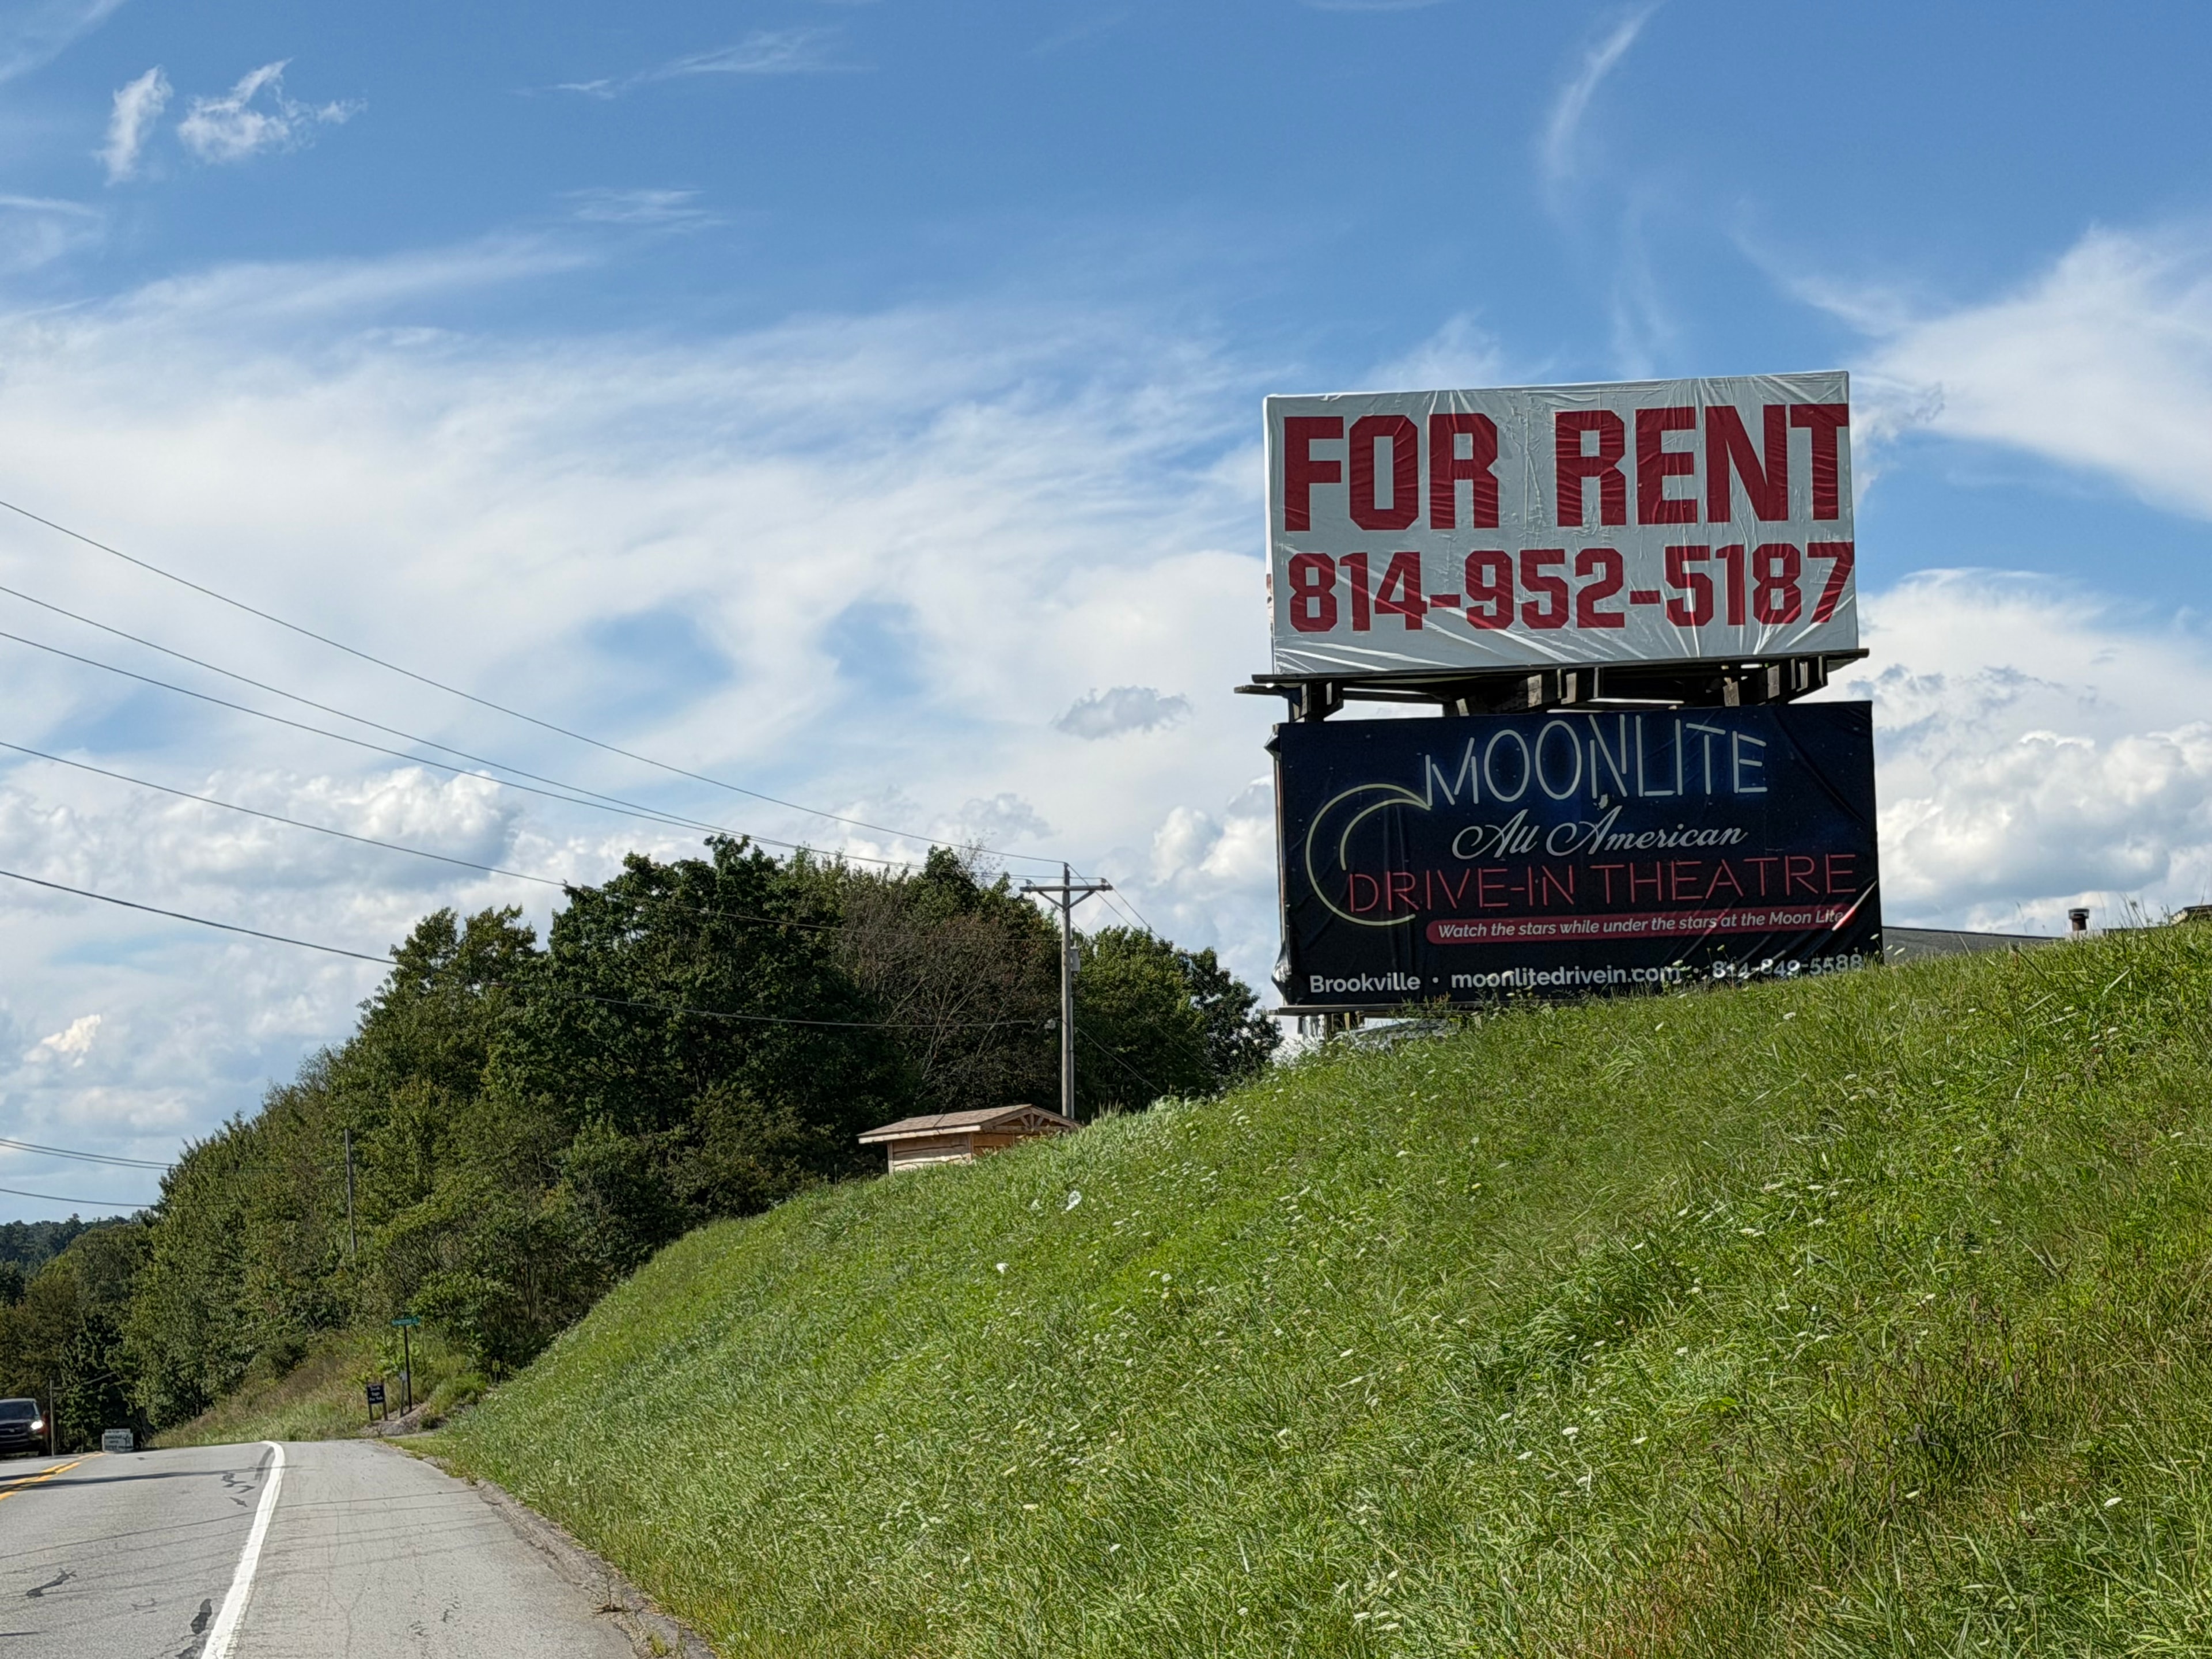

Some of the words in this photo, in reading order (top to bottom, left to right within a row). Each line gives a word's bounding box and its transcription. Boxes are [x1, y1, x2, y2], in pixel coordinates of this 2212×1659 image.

[1284, 412, 1499, 532] FOR
[1555, 403, 1849, 528] RENT
[1289, 541, 1854, 632] 814-952-5187
[1425, 714, 1768, 805] MOONLITE
[1452, 809, 1540, 859] All
[1546, 805, 1748, 856] American
[1349, 865, 1575, 913] DRIVE-IN
[1590, 854, 1857, 903] THEATRE
[1439, 924, 1487, 938] Watch
[1491, 922, 1515, 936] the
[1518, 922, 1557, 935] stars
[1559, 920, 1599, 934] while
[1603, 918, 1647, 933] under
[1651, 917, 1677, 930] the
[1679, 915, 1717, 929] stars
[1720, 914, 1737, 927] at
[1740, 913, 1765, 926] the
[1769, 911, 1811, 925] Moon
[1815, 909, 1844, 923] Lite
[1309, 971, 1421, 993] Brookville
[1450, 965, 1680, 988] moonlitedrivein.com
